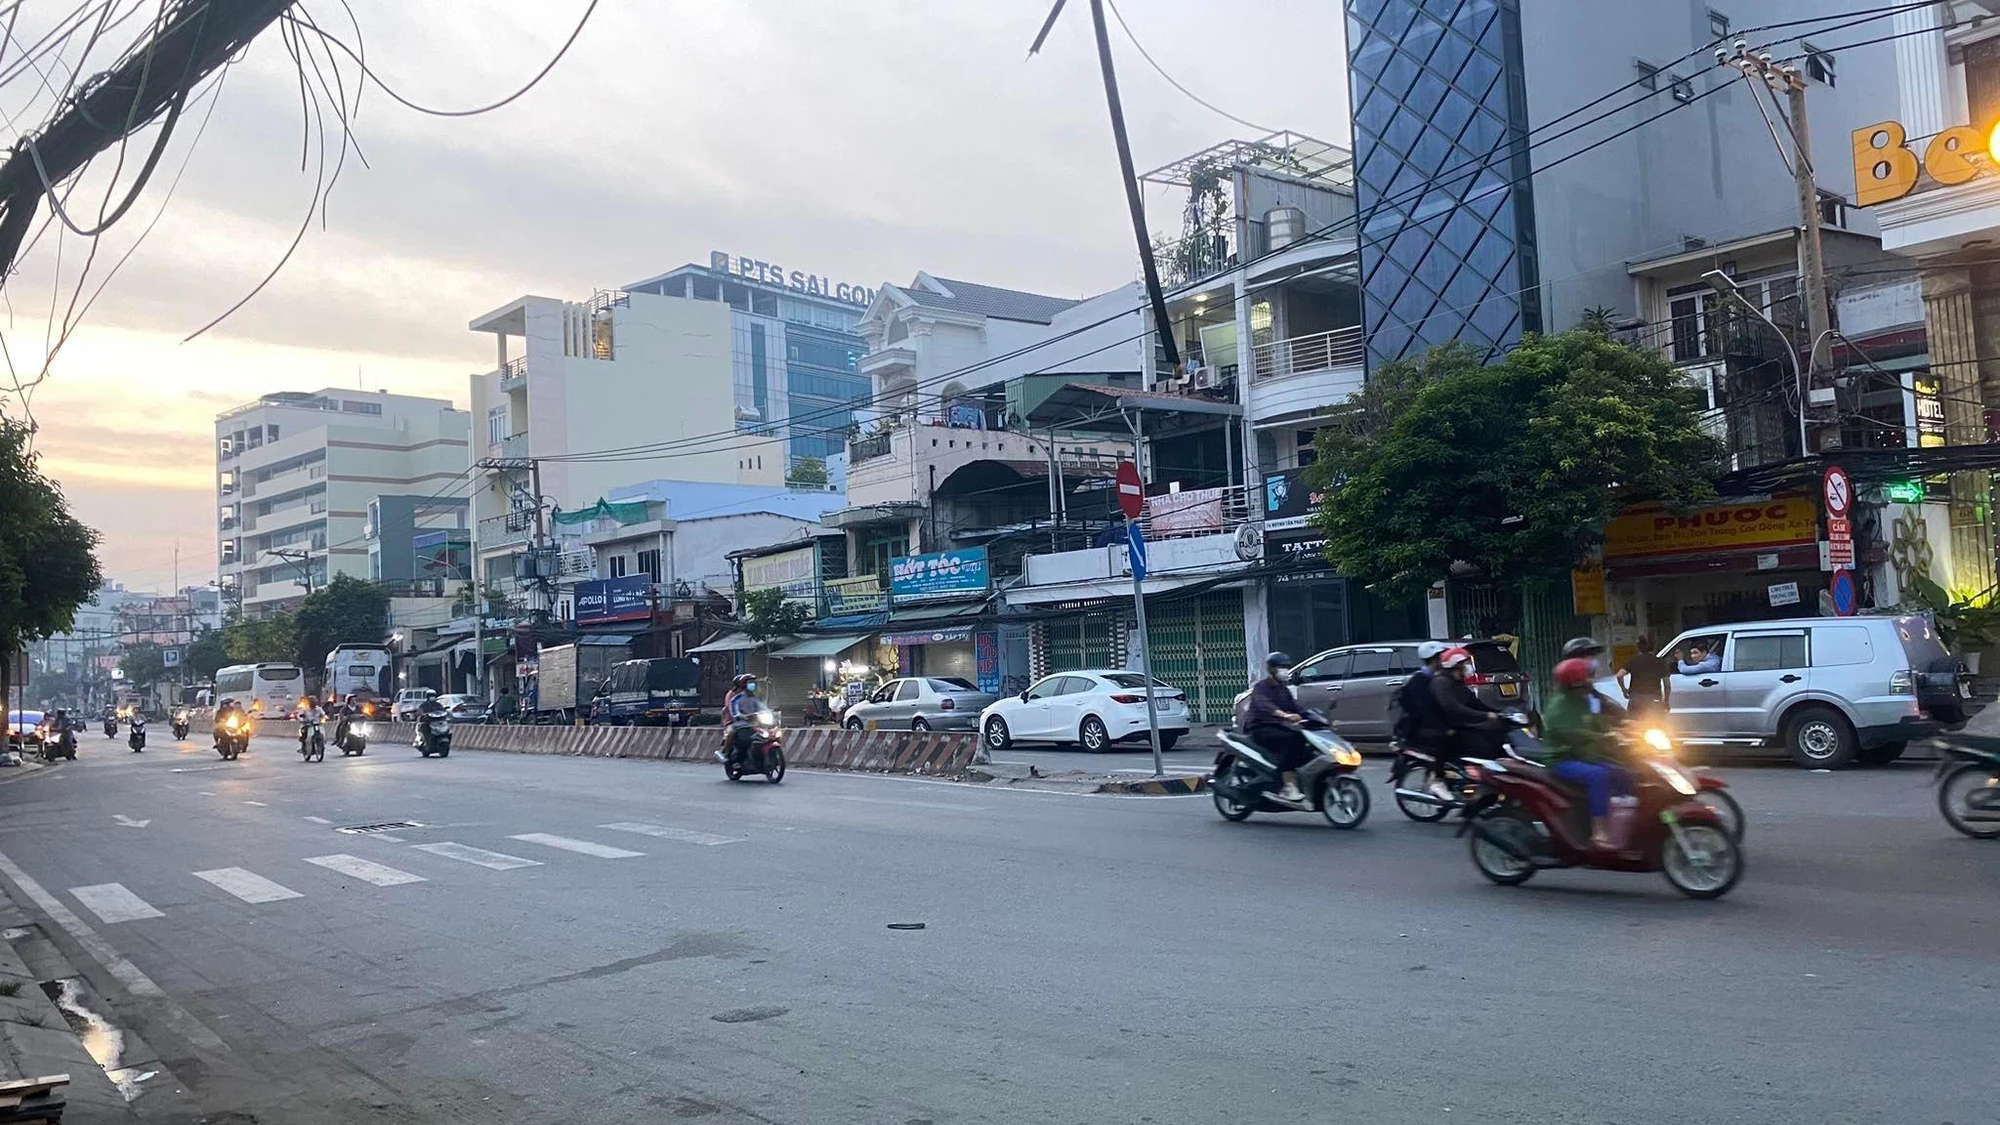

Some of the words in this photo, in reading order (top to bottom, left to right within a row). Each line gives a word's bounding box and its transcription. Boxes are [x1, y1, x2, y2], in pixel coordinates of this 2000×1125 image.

[740, 256, 784, 289] PTS
[1917, 399, 1944, 419] HOTEL
[578, 595, 603, 607] APOLLO
